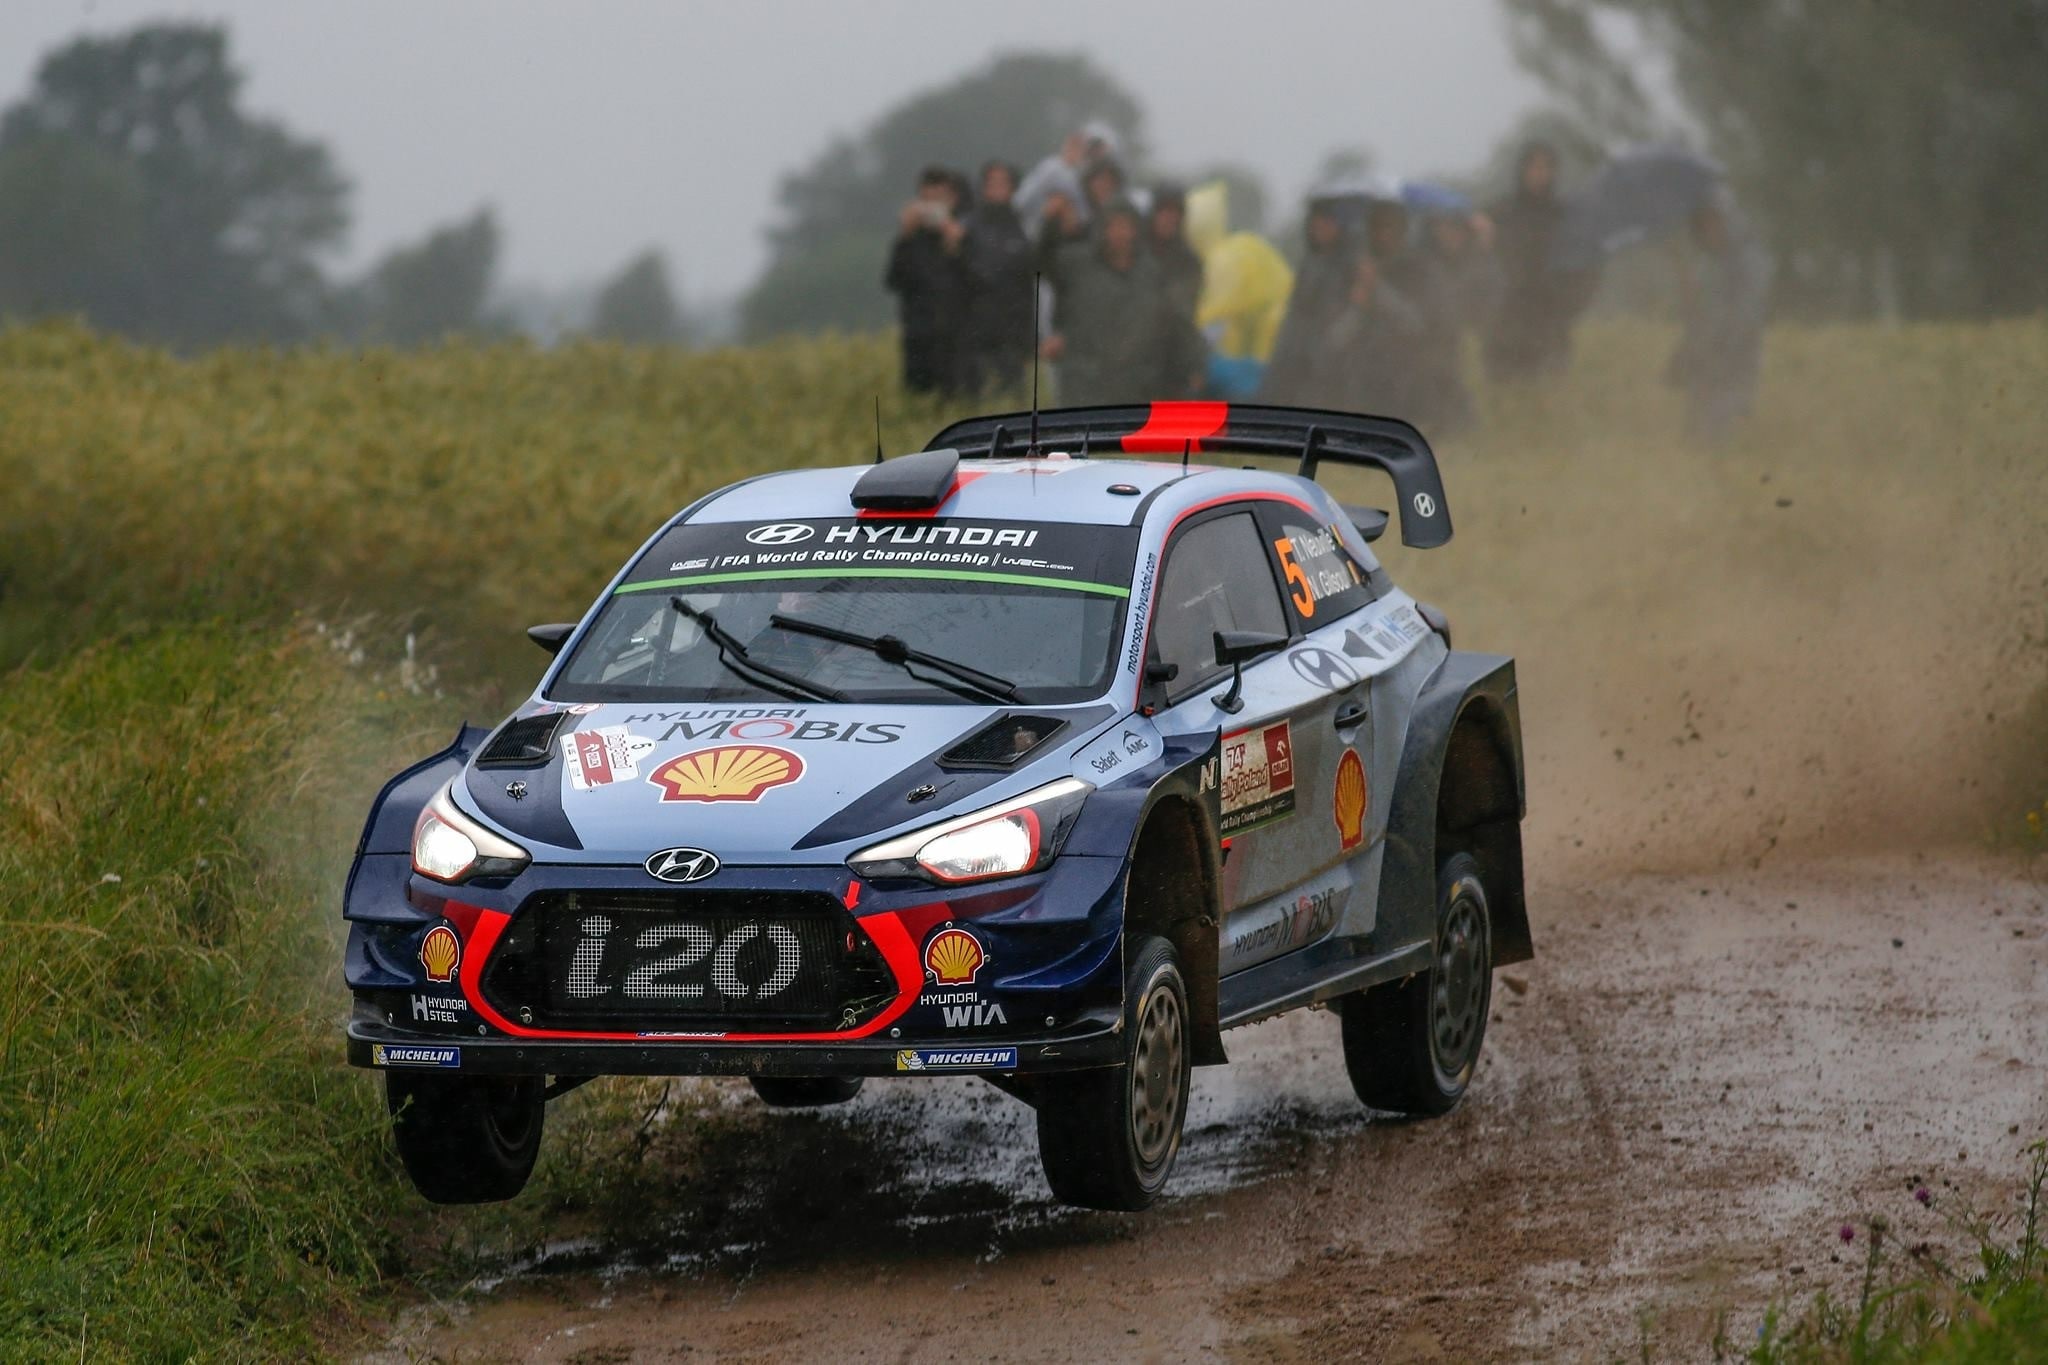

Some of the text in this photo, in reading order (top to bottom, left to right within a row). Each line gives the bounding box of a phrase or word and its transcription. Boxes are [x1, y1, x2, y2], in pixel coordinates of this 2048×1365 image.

[824, 525, 1038, 548] HYUNDAI
[721, 549, 990, 567] FIA World Rally Championship
[1275, 537, 1315, 617] 5
[1127, 552, 1158, 675] motorsport.hyundai.com
[623, 708, 808, 723] HYUNDAI
[658, 718, 906, 744] MOBIS
[1091, 749, 1122, 774] Sabelt
[1221, 762, 1269, 804] ally Poland
[565, 914, 802, 1000] i20
[428, 995, 467, 1012] HYUNDAI
[920, 992, 978, 1006] HYUNDAI
[429, 1009, 458, 1023] STEEL
[389, 1048, 455, 1062] MICHELIN
[927, 1051, 1011, 1065] MICHELIN
